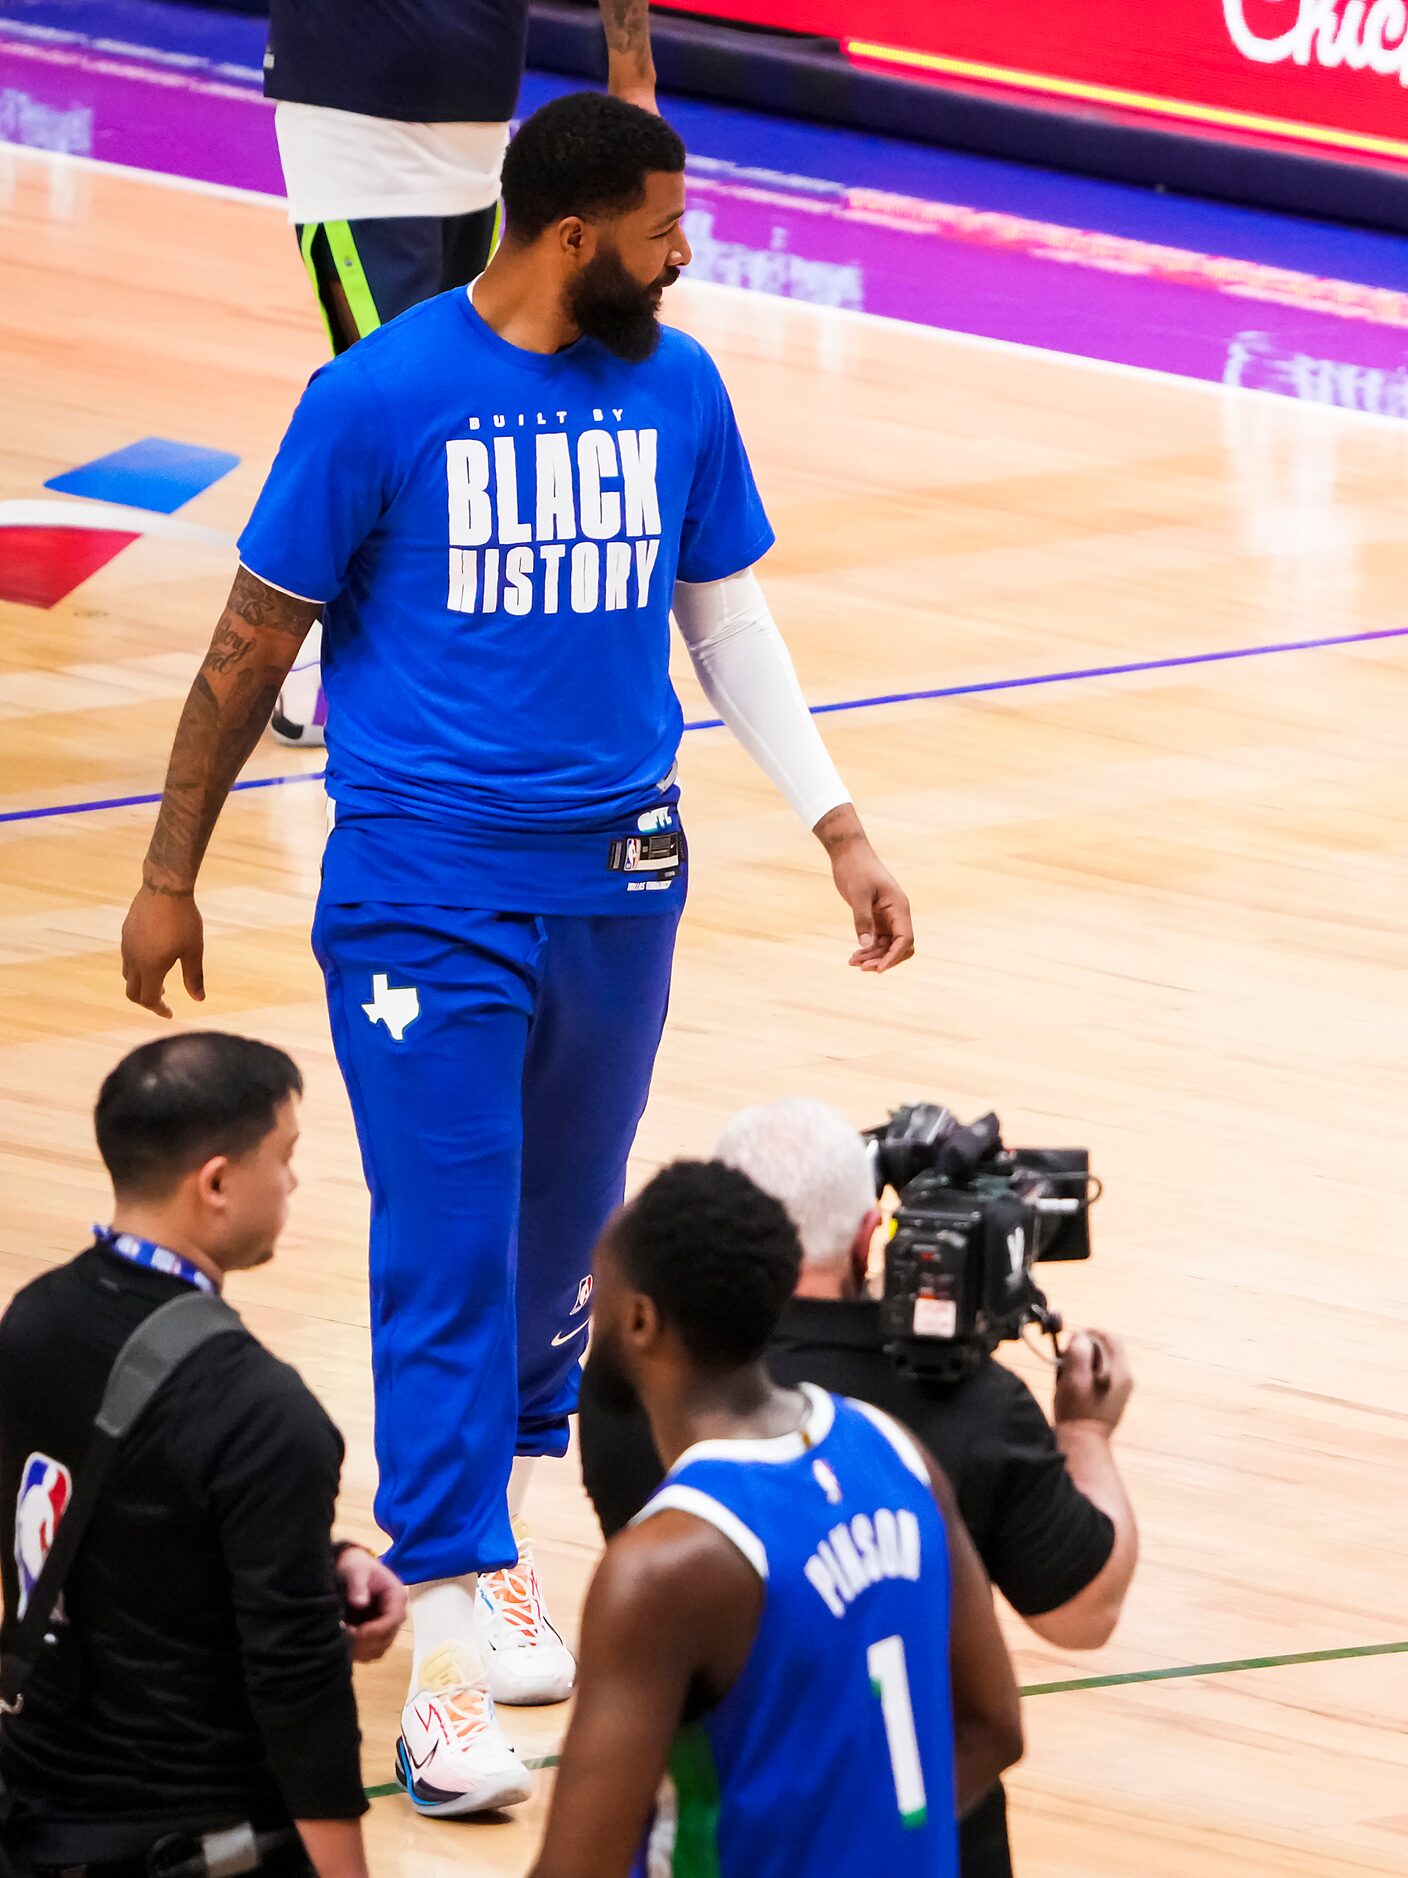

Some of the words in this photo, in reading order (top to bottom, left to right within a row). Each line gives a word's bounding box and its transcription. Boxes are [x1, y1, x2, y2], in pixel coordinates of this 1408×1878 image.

[468, 410, 568, 431] BUILT
[592, 408, 624, 422] BY
[446, 428, 662, 547] BLACK
[446, 539, 661, 616] HISTORY
[866, 1634, 927, 1827] 1
